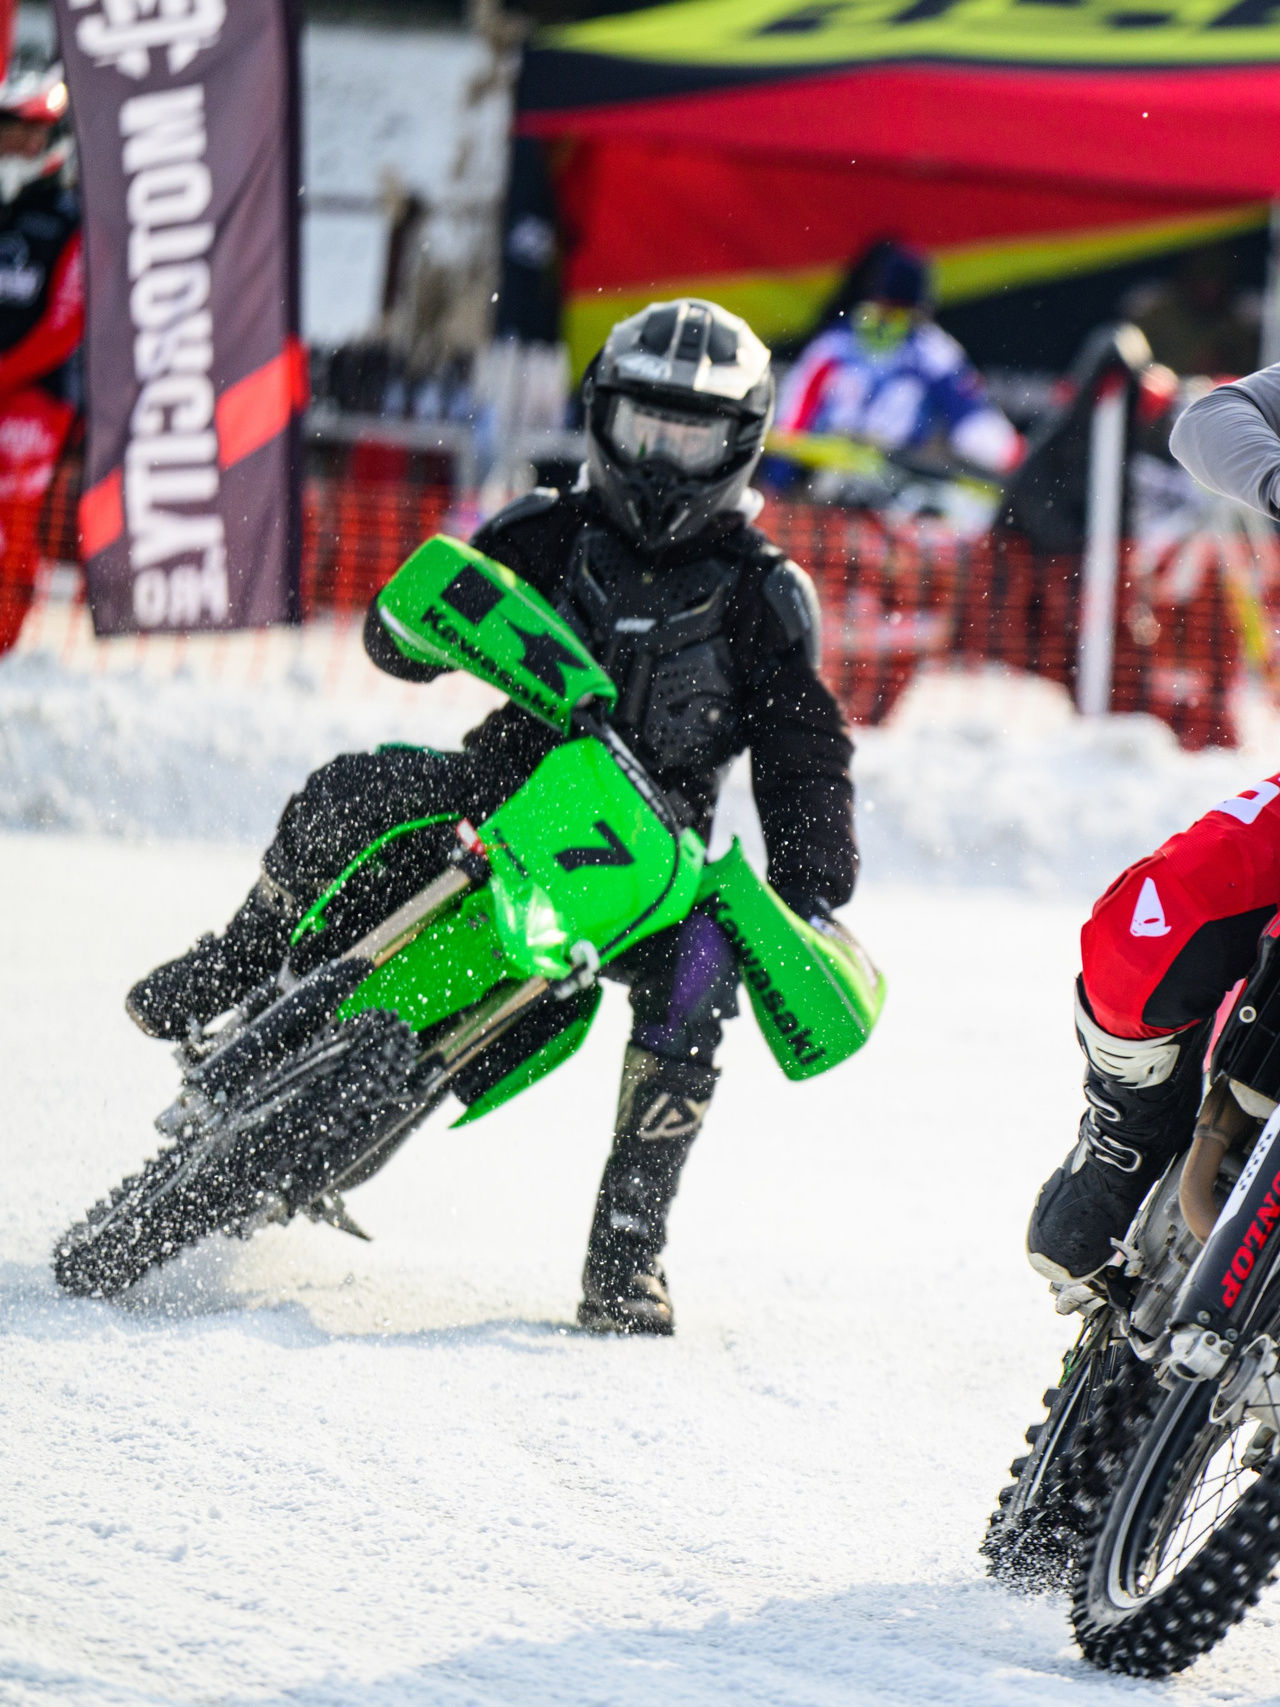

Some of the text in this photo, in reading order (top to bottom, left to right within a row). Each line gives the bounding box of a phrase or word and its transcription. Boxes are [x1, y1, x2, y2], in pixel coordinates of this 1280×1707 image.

[421, 605, 558, 717] Kawasaki
[554, 819, 635, 873] 7
[700, 889, 826, 1067] Kawasaki
